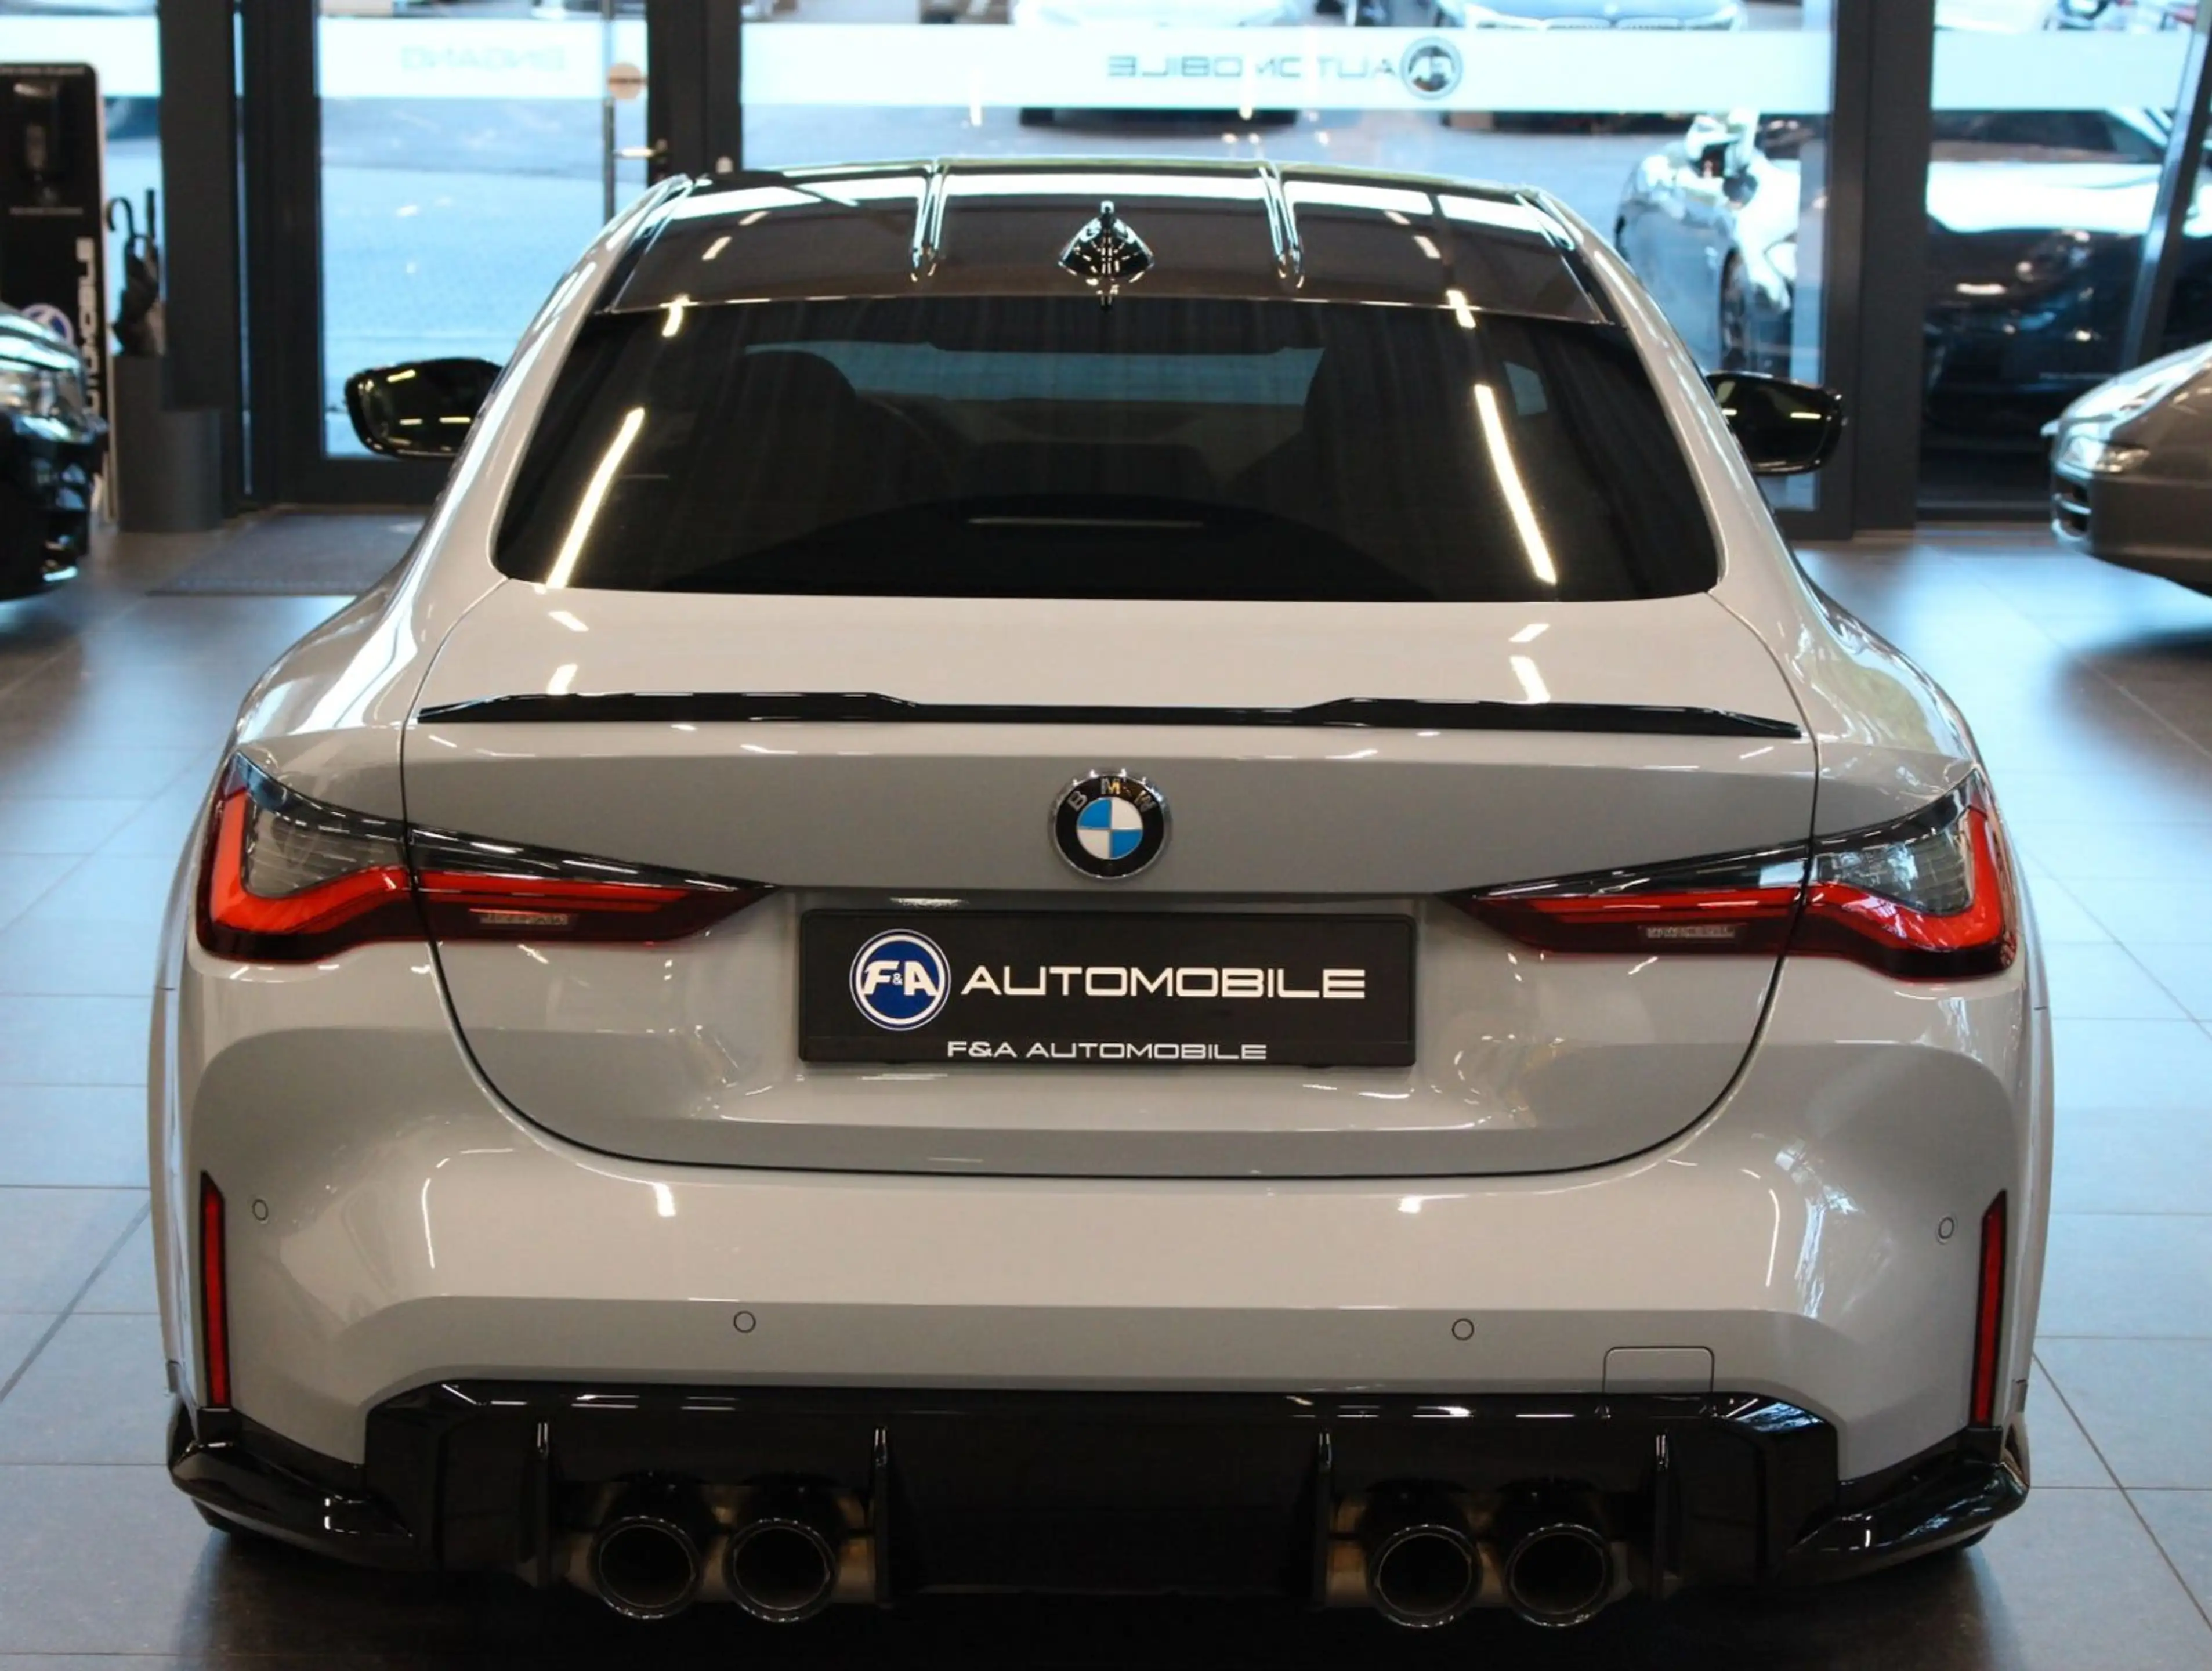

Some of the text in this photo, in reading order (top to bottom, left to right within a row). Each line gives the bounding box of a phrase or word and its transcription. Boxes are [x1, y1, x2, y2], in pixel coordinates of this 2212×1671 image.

[1067, 777, 1157, 812] BMW
[863, 960, 1366, 999] F&A AUTOMOBILE
[947, 1041, 1267, 1061] F&A AUTOMOBILE
